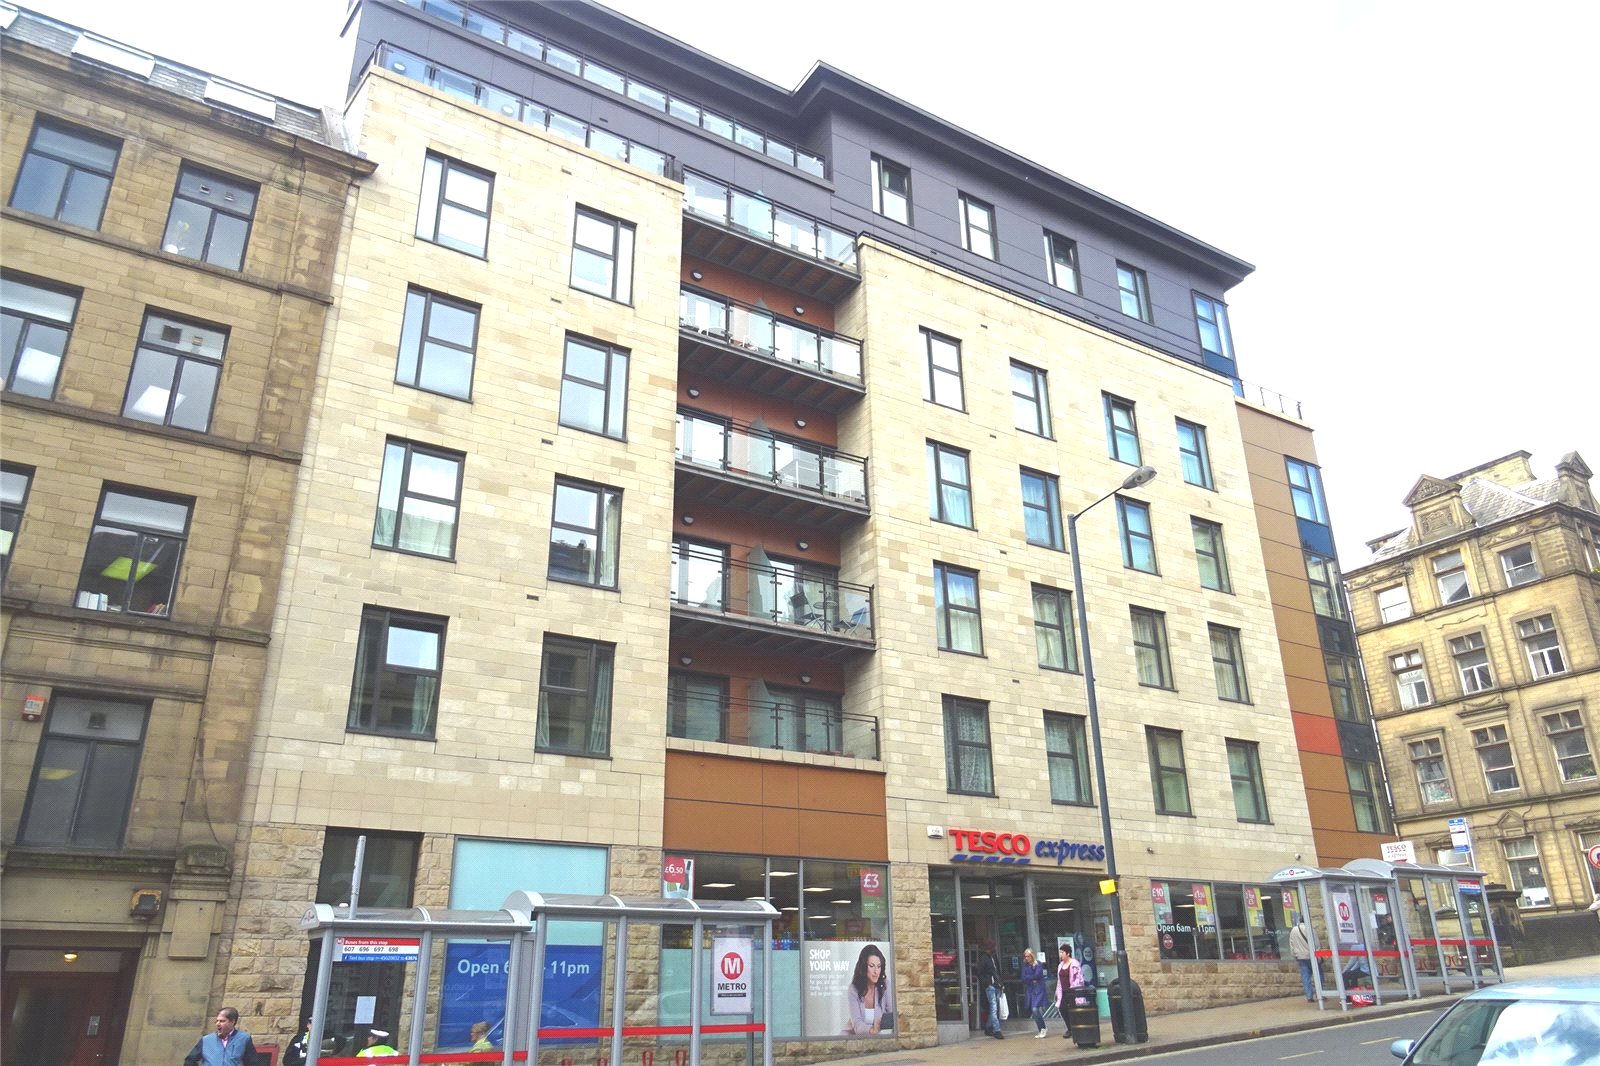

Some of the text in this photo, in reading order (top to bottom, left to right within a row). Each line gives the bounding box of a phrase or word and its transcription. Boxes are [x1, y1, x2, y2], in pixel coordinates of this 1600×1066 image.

[949, 829, 1105, 865] TESCO express
[664, 863, 684, 874] £6.50
[863, 873, 880, 888] £3
[1151, 887, 1164, 897] £10
[1283, 892, 1292, 903] £1
[1157, 924, 1175, 934] Open
[1176, 923, 1191, 932] 6am
[1197, 924, 1216, 934] 11pm
[810, 949, 831, 960] SHOP
[457, 959, 499, 977] Open
[550, 960, 590, 977] 11pm
[724, 957, 741, 974] M
[810, 960, 850, 971] YOUR WAY
[717, 982, 747, 991] METRO
